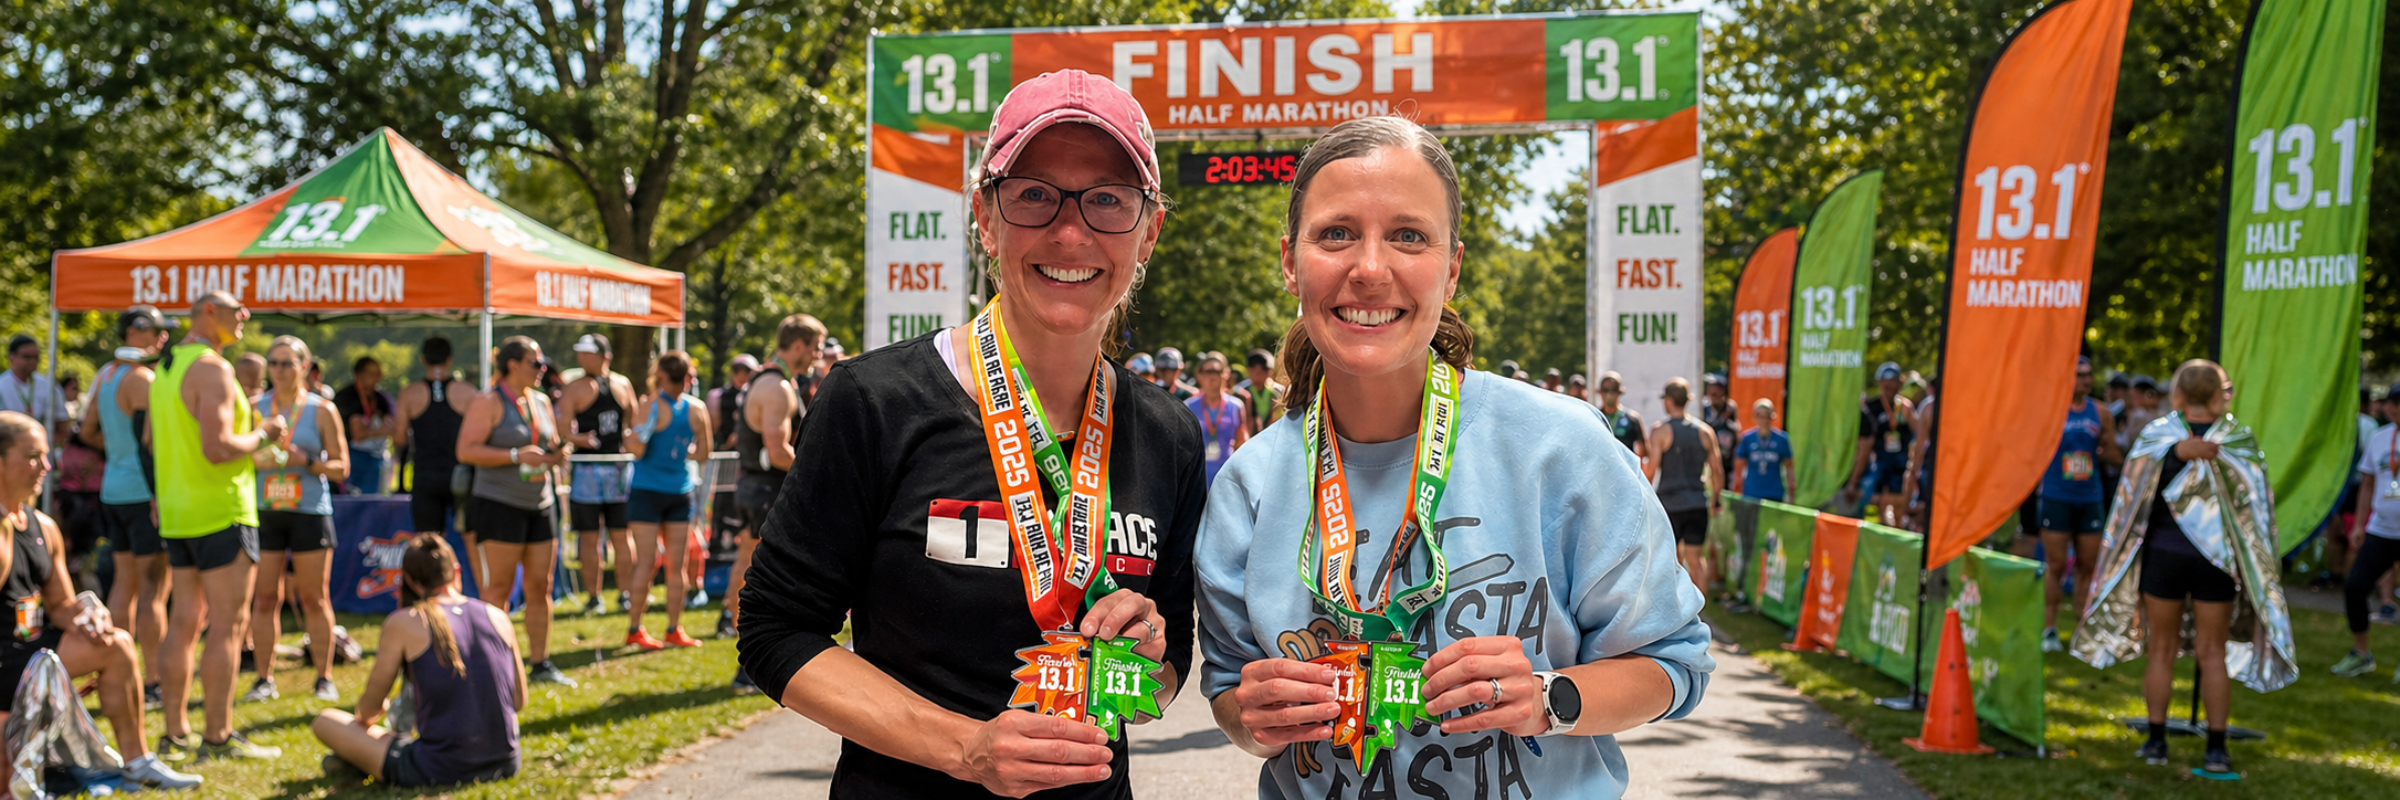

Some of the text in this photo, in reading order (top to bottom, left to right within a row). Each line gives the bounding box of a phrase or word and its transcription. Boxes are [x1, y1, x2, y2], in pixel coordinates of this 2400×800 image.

[902, 53, 989, 114] 13.1
[1113, 32, 1433, 98] FINISH
[1560, 36, 1657, 102] 13.1
[1168, 100, 1389, 124] HALF MARATHON
[1205, 156, 1296, 183] 2:03:45
[2248, 118, 2358, 214] 13.1
[1617, 205, 1680, 235] FLAT.
[1974, 163, 2077, 240] 13.1
[268, 200, 380, 243] 13.1
[889, 211, 947, 240] FLAT.
[2245, 219, 2303, 254] HALF
[888, 263, 947, 292] FAST.
[1616, 258, 1683, 288] FAST.
[1969, 247, 2025, 276] HALF
[2242, 253, 2358, 291] MARATHON
[130, 264, 404, 303] 13.1 HALF MARATHON
[1966, 279, 2083, 308] MARATHON
[1801, 285, 1857, 330] 13.1
[1618, 313, 1677, 343] FUN!
[1737, 310, 1780, 347] 13.1
[994, 419, 1030, 487] 2025
[1077, 424, 1104, 490] 2025
[959, 505, 979, 559] 1
[1322, 482, 1349, 549] 2025
[1107, 511, 1158, 561] ACE
[1406, 576, 1549, 657] ASTA
[1038, 666, 1075, 692] 13.1
[1104, 671, 1142, 697] 13.1
[1383, 678, 1420, 704] 13.1
